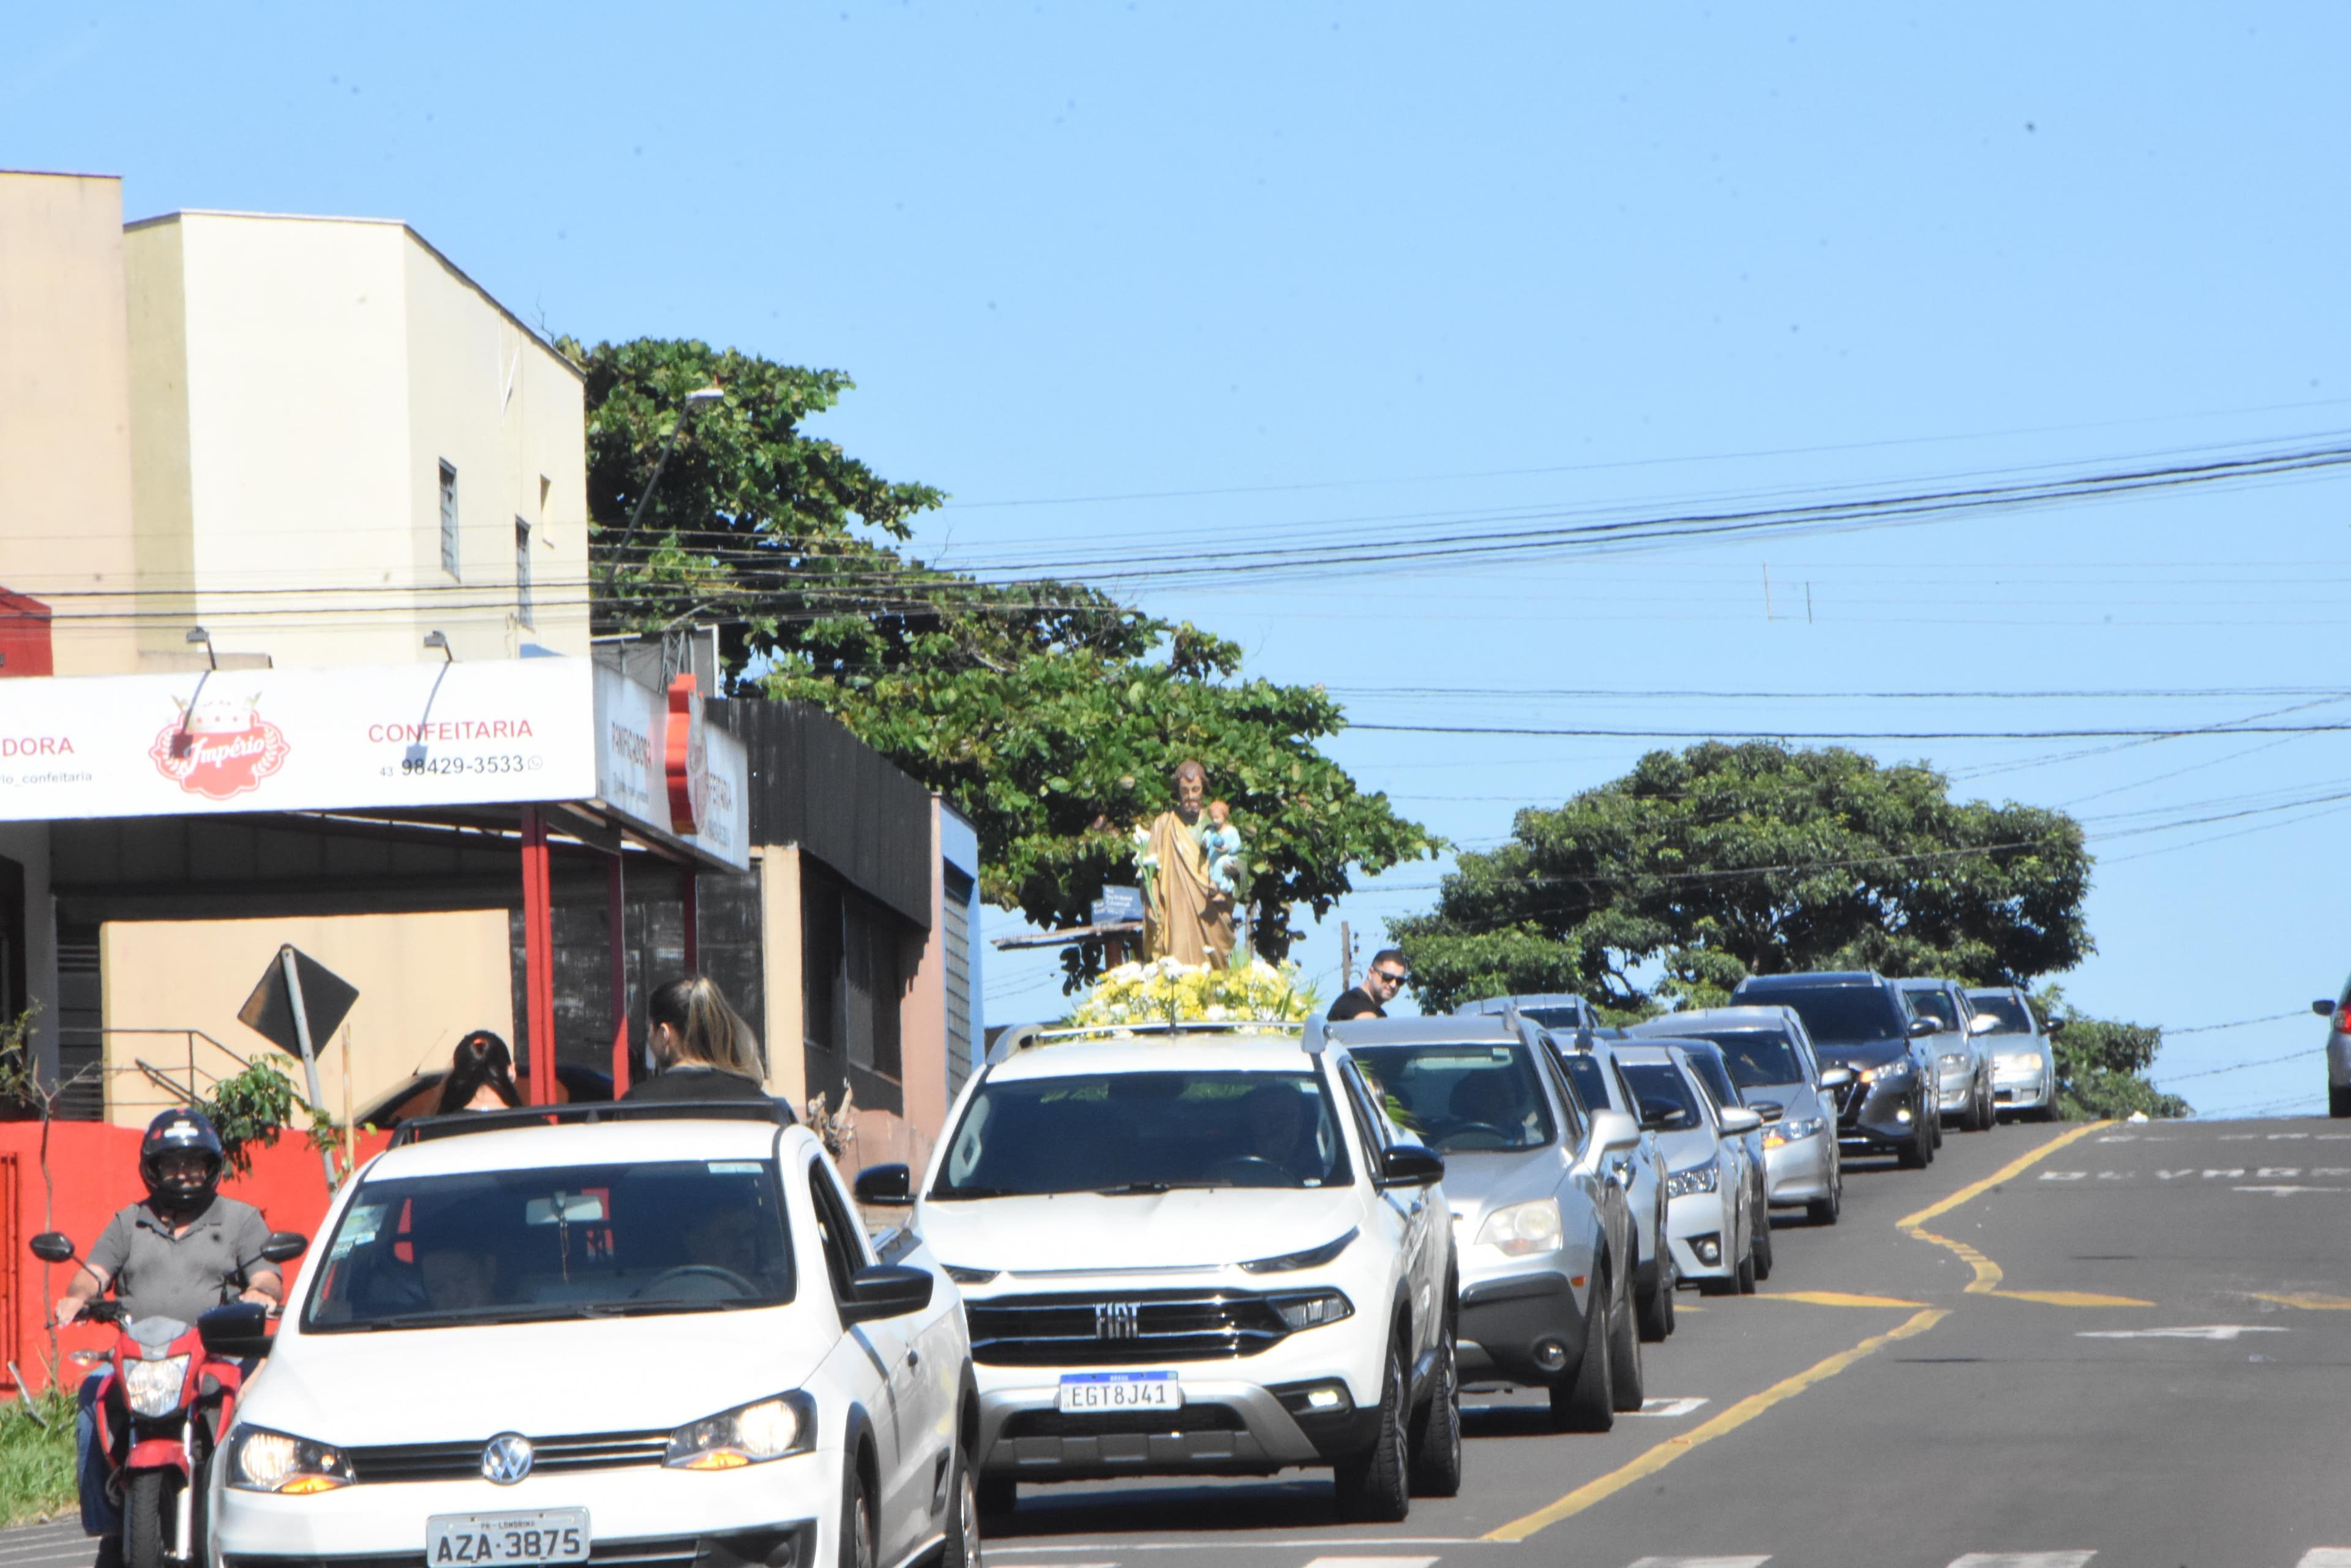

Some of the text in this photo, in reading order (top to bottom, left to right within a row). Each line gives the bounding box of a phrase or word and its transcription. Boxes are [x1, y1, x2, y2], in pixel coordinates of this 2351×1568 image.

[369, 719, 533, 743] CONFEITARIA
[2, 737, 75, 757] DORA
[185, 735, 265, 777] Império
[380, 755, 524, 777] 43 98429-3533
[0, 771, 92, 787] io_confeitaria
[1095, 1302, 1142, 1339] FIAT
[1072, 1384, 1166, 1407] EGT8J41
